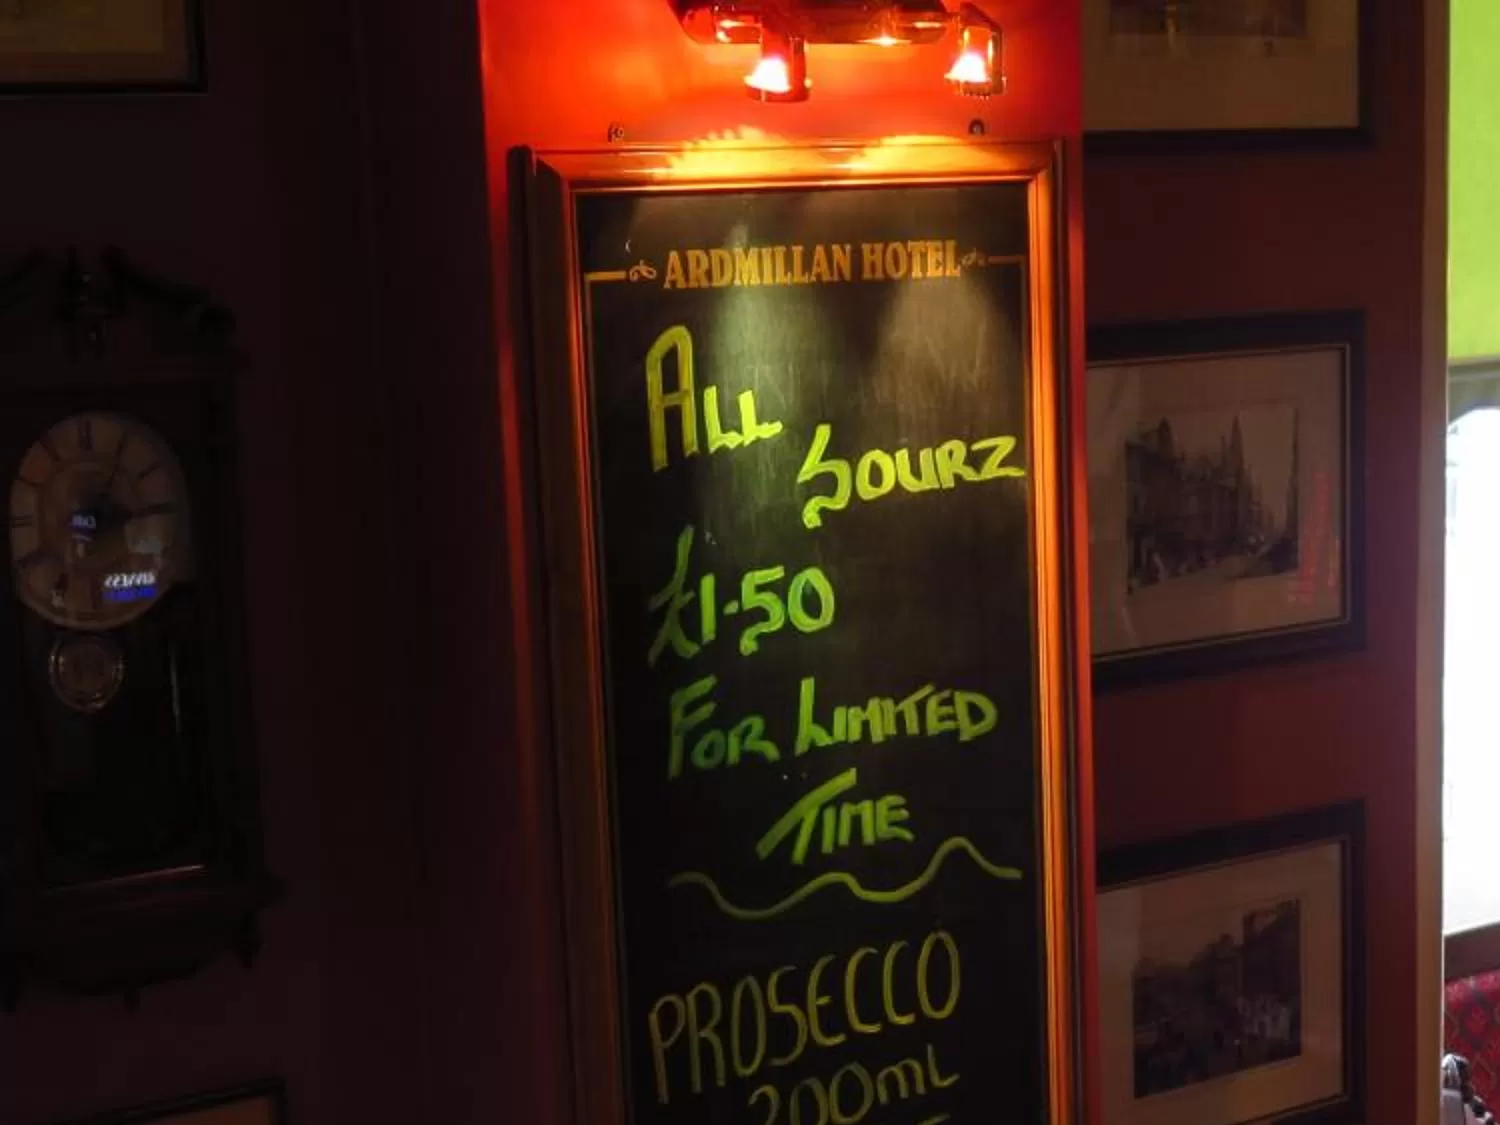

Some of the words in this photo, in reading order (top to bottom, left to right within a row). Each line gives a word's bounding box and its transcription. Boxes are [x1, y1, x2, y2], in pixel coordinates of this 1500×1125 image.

[663, 245, 852, 289] ARDMILLAN
[861, 240, 962, 279] HOTEL
[648, 931, 961, 1104] PROSECCO
